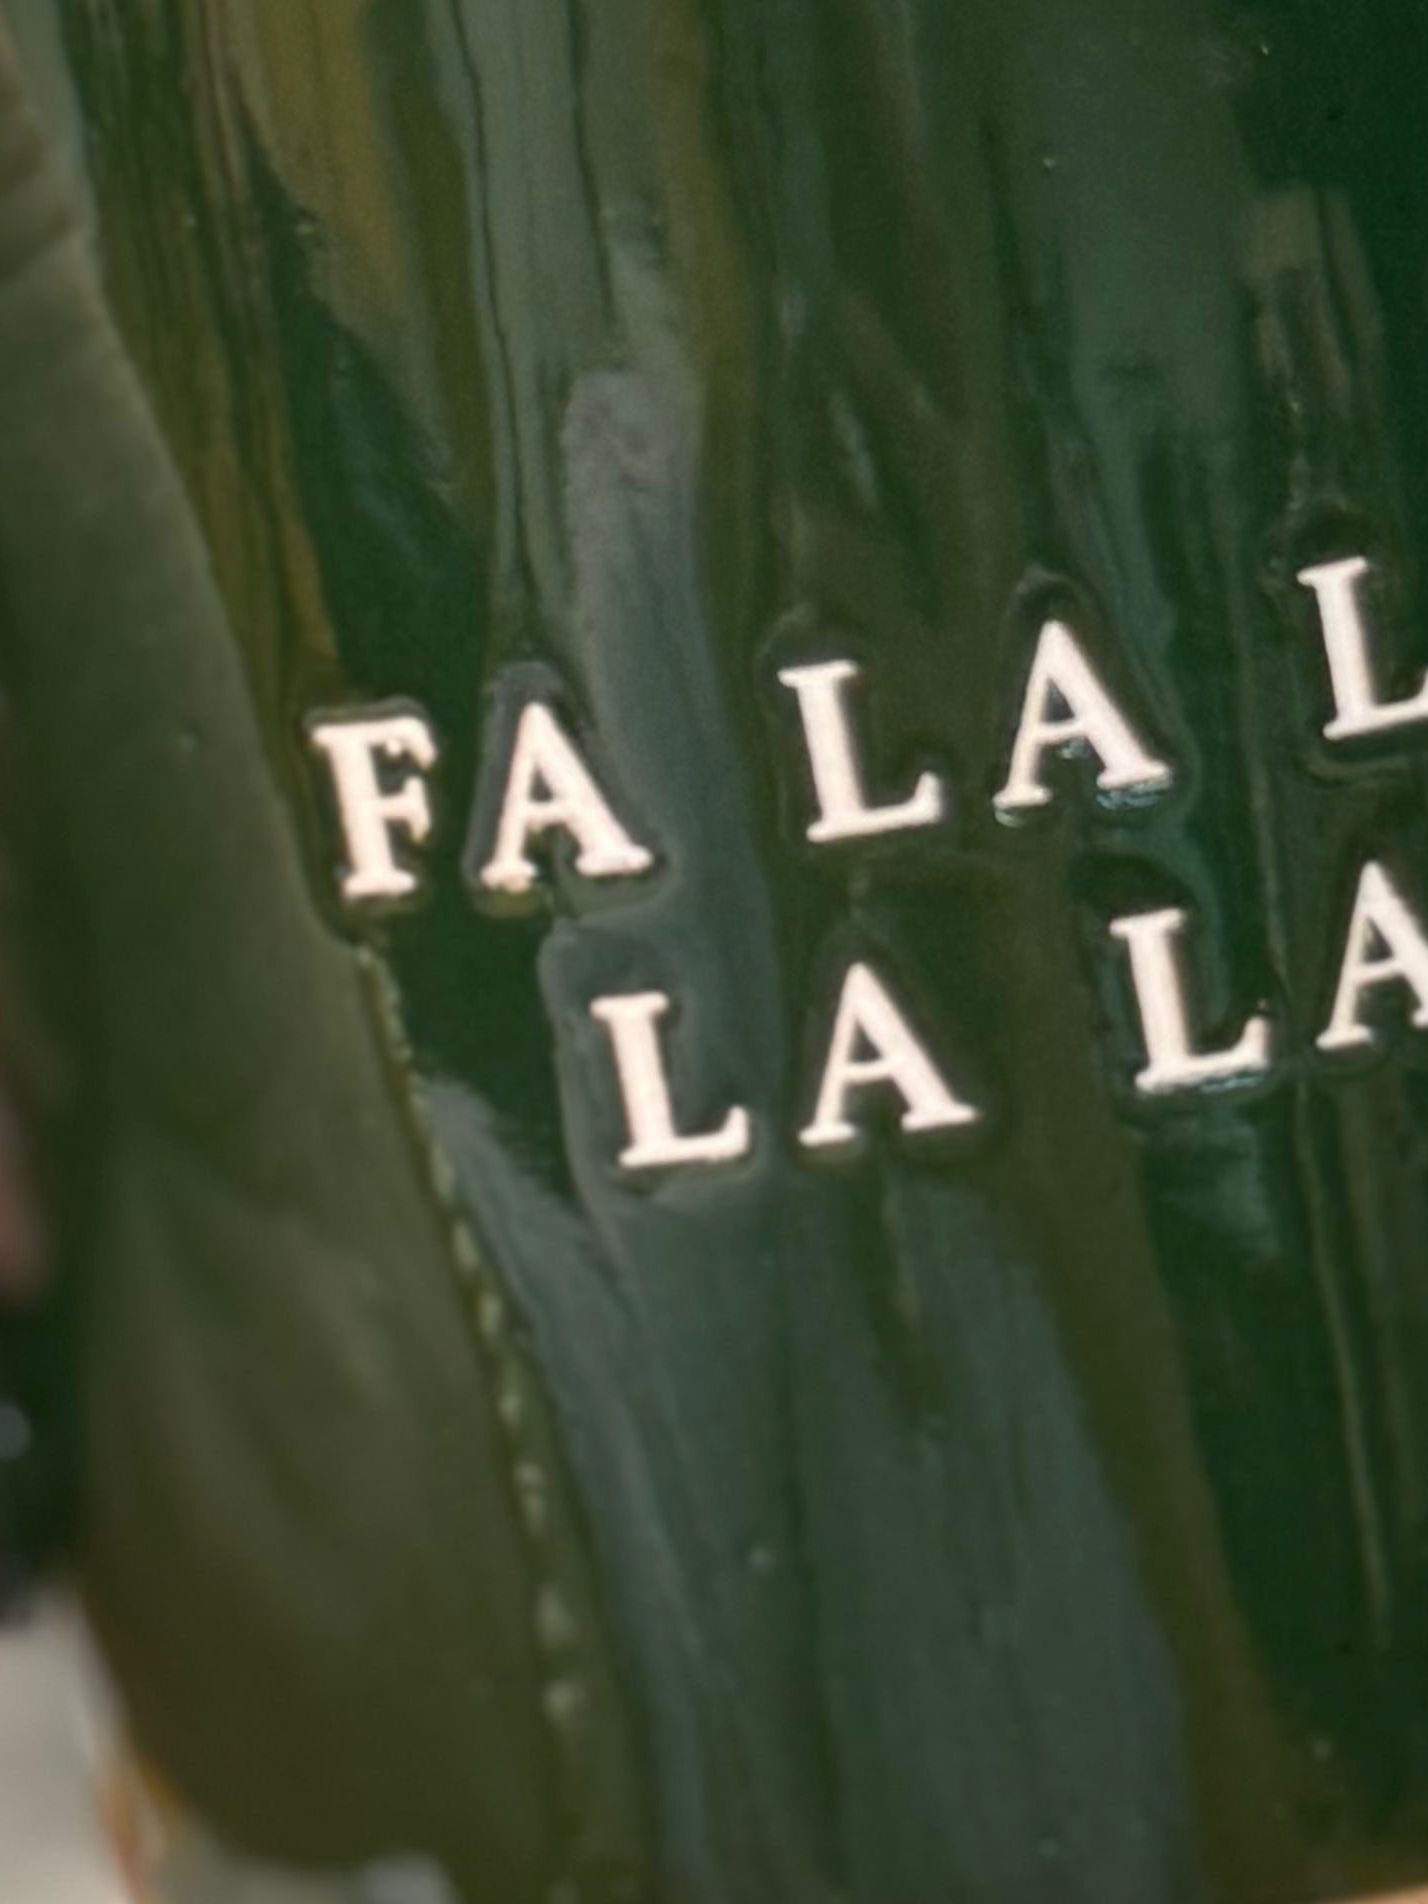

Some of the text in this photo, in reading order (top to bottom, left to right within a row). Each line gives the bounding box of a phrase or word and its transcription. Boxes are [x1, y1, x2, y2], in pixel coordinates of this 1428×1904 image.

[309, 701, 653, 896] FA
[778, 620, 1171, 842] LA
[590, 962, 976, 1168] LA
